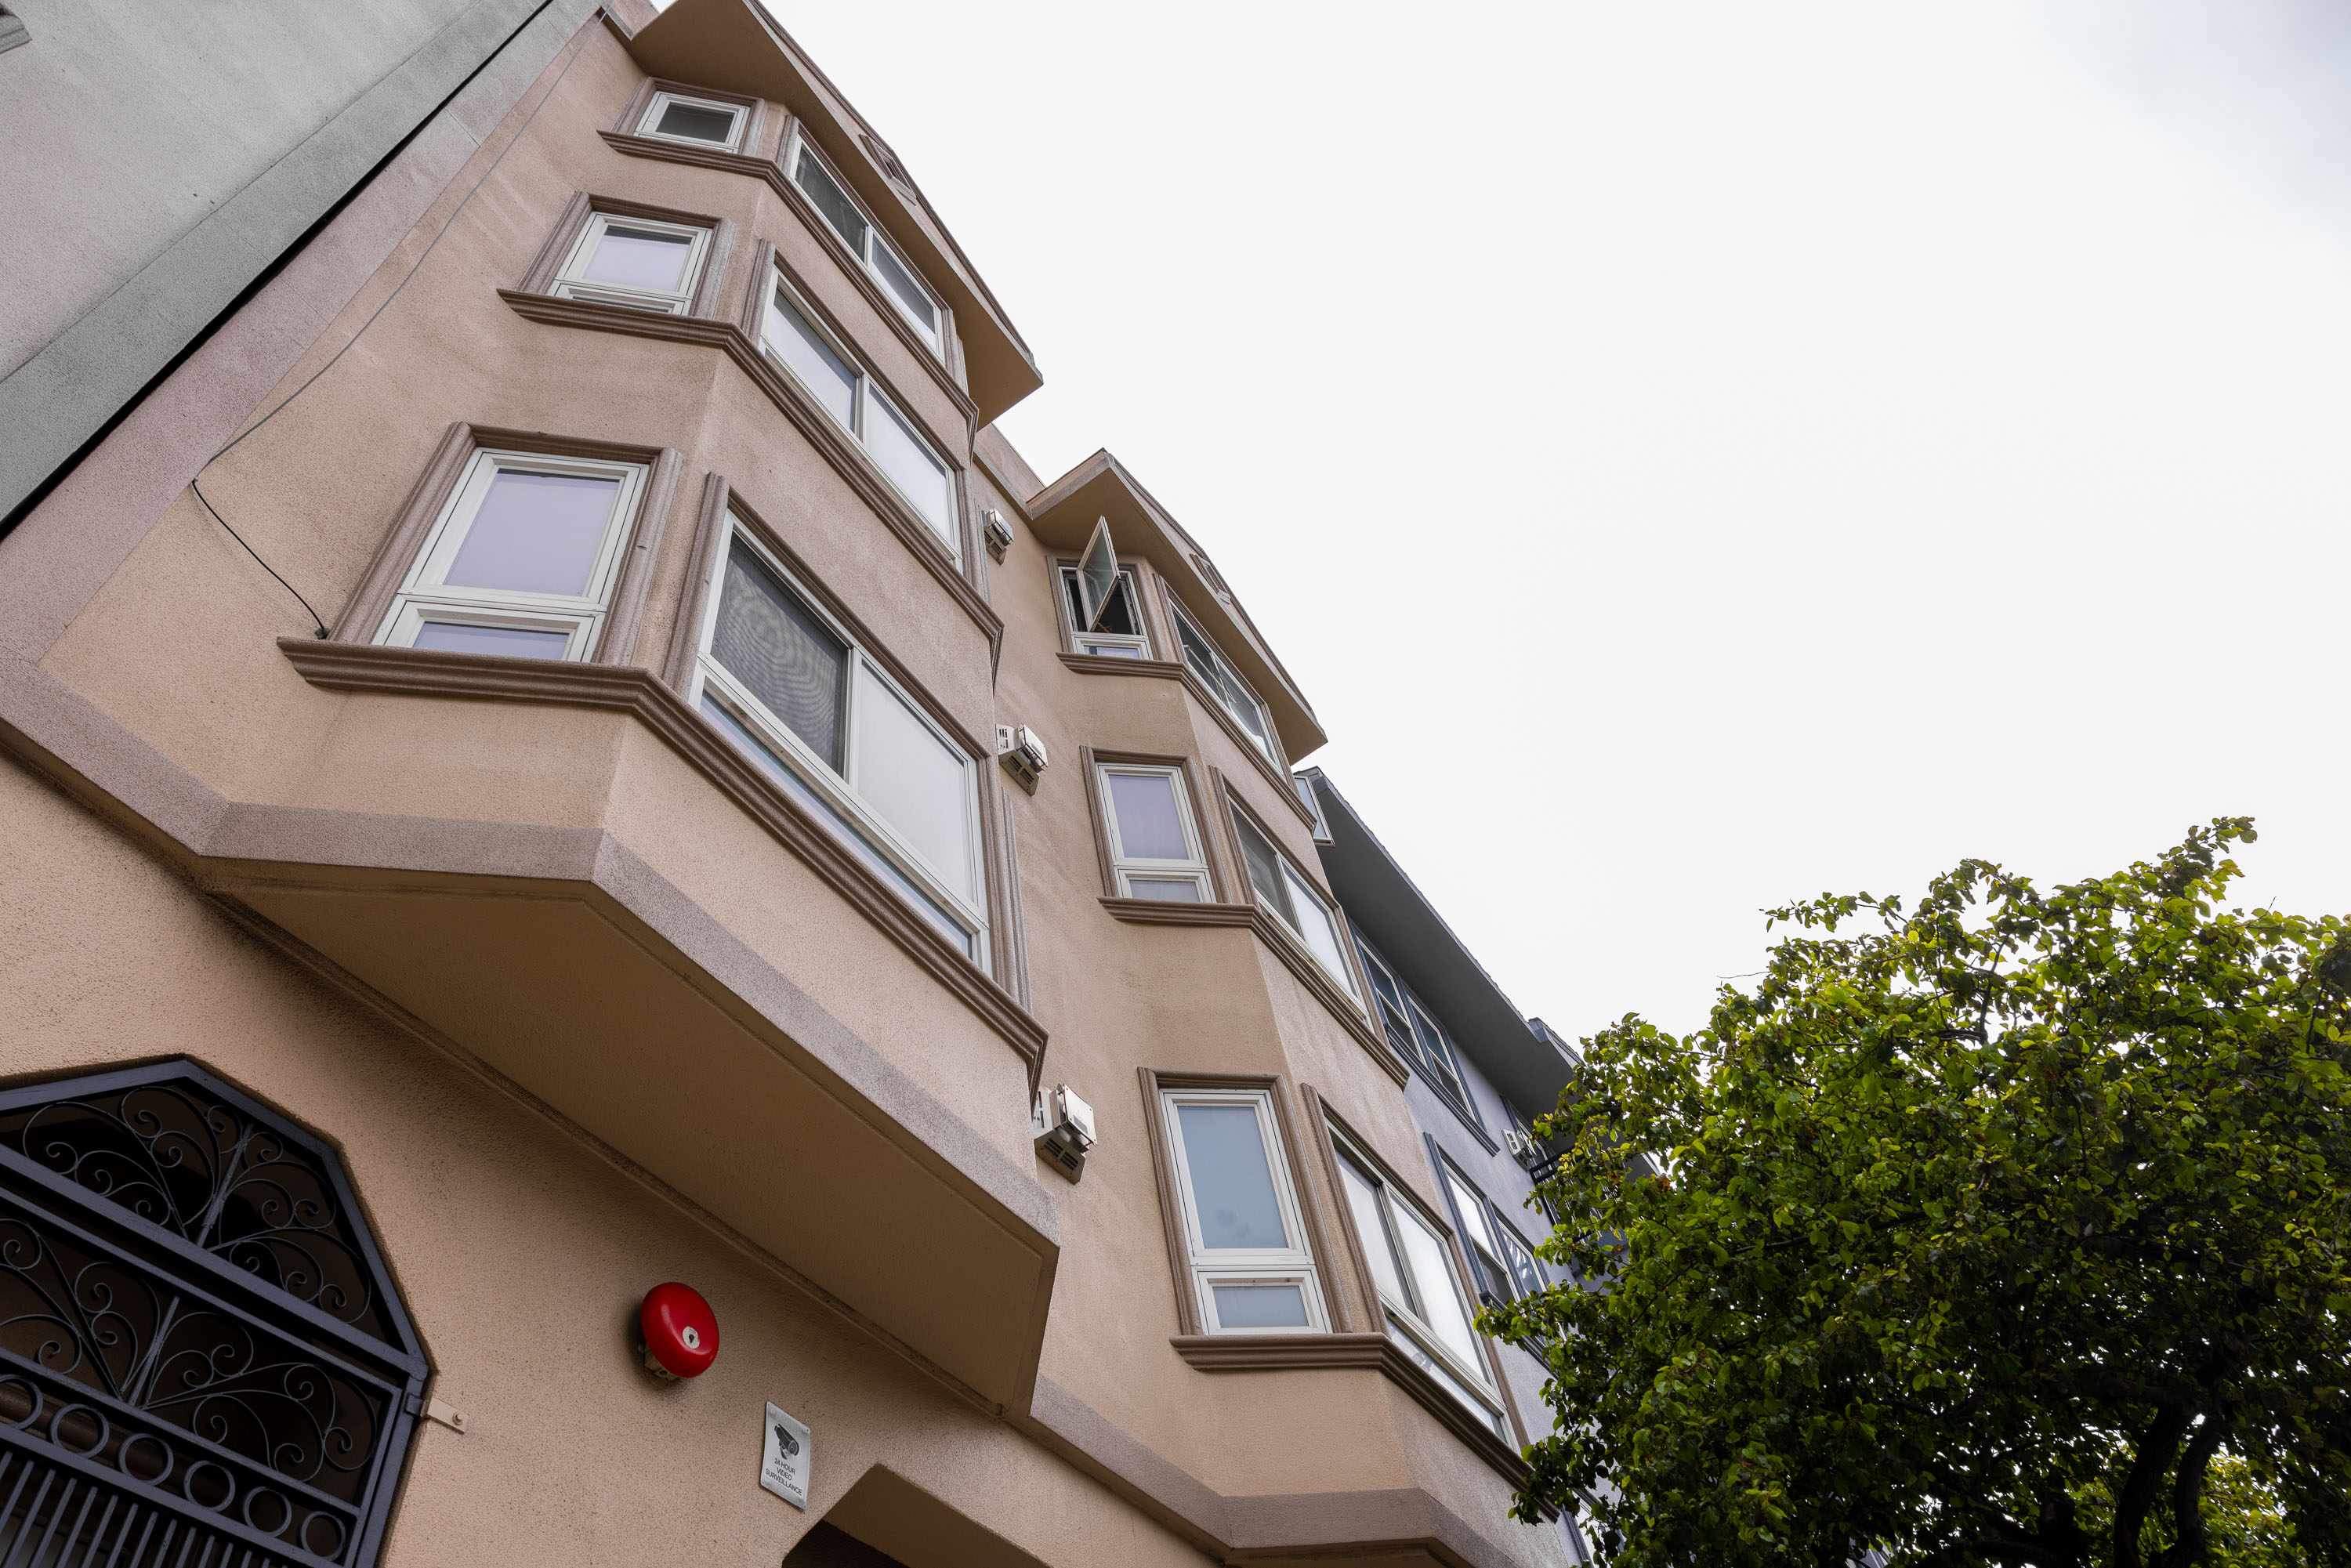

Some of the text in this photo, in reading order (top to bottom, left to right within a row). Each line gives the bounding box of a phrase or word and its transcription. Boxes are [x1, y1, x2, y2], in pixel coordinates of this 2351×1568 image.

[774, 1458, 796, 1475] 24 HOUR
[777, 1467, 792, 1481] VIDEO
[765, 1468, 802, 1496] SURVEILLANCE
